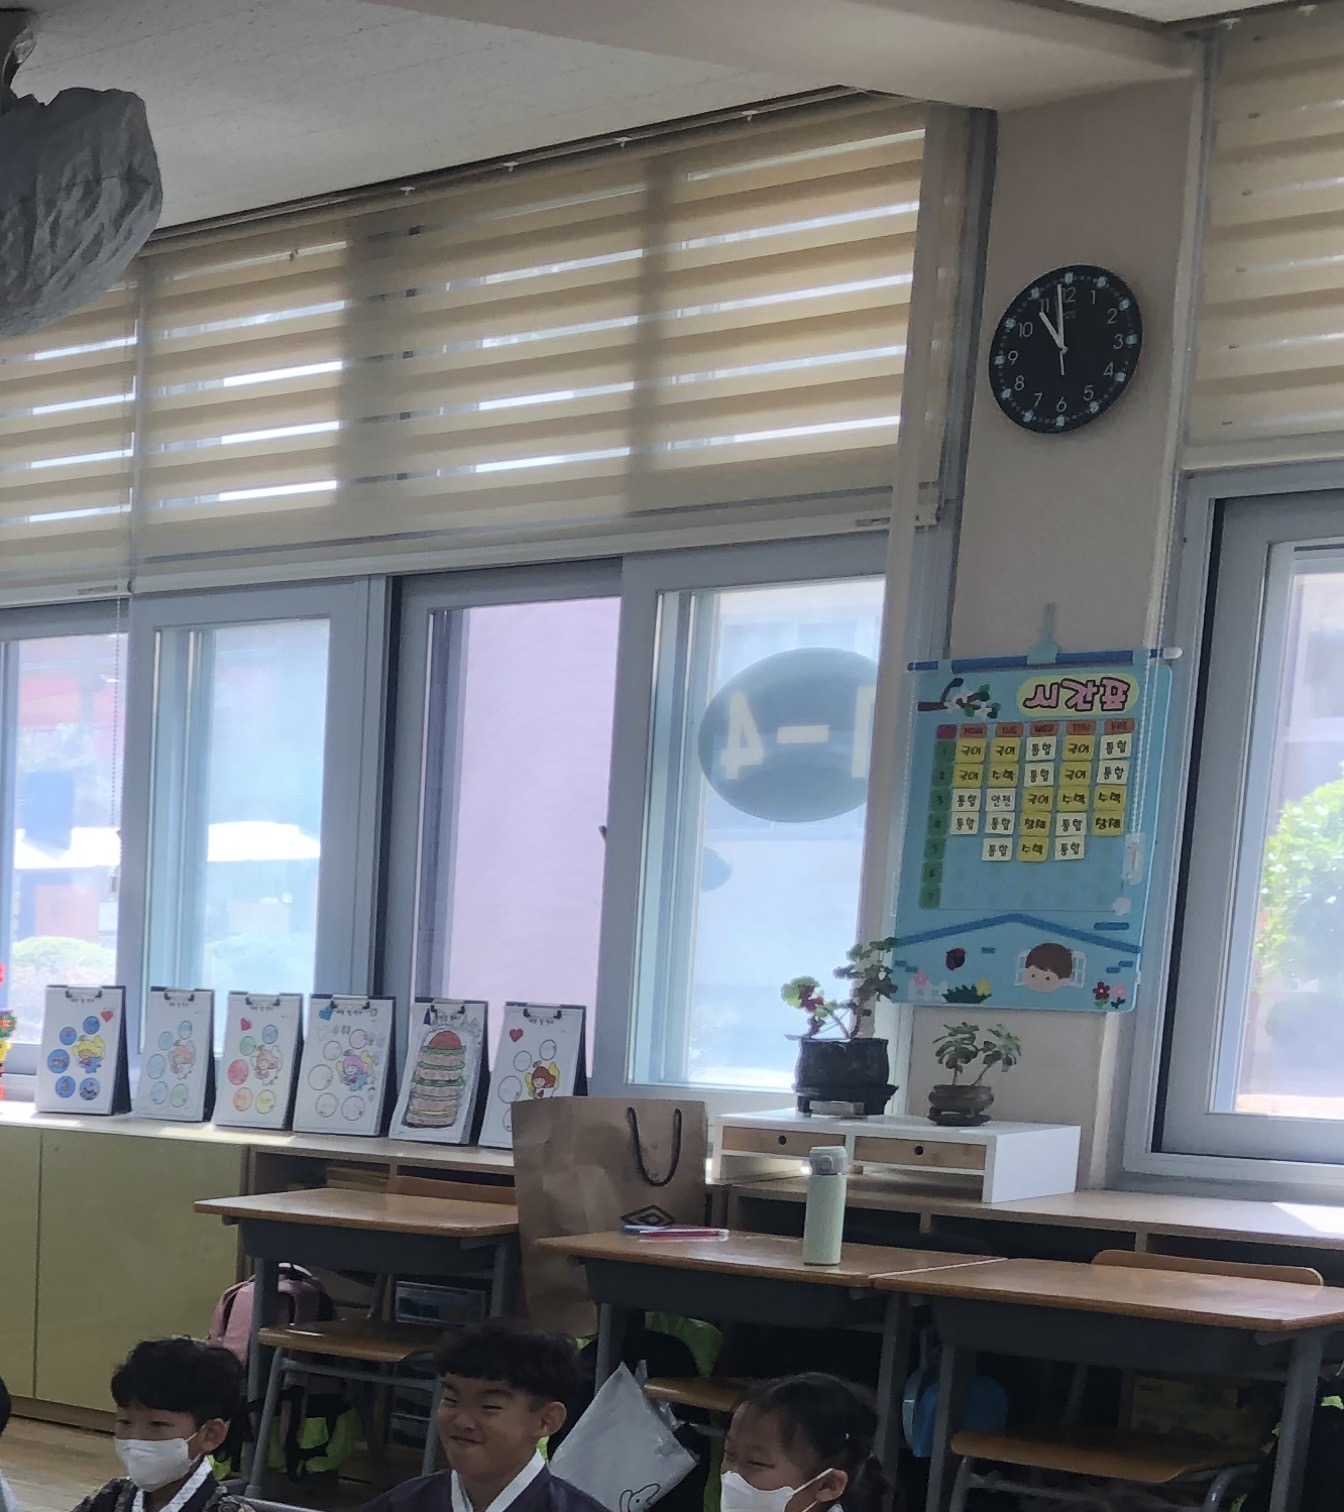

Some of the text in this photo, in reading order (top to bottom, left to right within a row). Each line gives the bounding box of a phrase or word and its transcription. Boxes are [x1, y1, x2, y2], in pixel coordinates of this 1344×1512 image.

[1091, 289, 1097, 304] 1
[1107, 307, 1118, 324] 2
[1018, 321, 1034, 337] 10
[1113, 333, 1124, 349] 3
[1008, 350, 1018, 365] 9
[1103, 361, 1114, 377] 4
[1014, 374, 1025, 391] 8
[1033, 392, 1043, 408] 7
[1083, 384, 1094, 401] 5
[1056, 397, 1067, 412] 6
[1022, 676, 1132, 712] 시간표
[961, 744, 982, 757] 국어
[995, 744, 1016, 757] 국어
[1068, 743, 1090, 755] 국어
[959, 769, 980, 782] 국어
[1064, 769, 1087, 781] 국어
[956, 794, 977, 808] 통합
[1027, 793, 1050, 805] 국어
[956, 816, 976, 831] 통합
[991, 816, 1012, 831] 통합
[1061, 818, 1083, 832] 통합
[987, 843, 1009, 857] 통합
[1060, 842, 1081, 857] 통합
